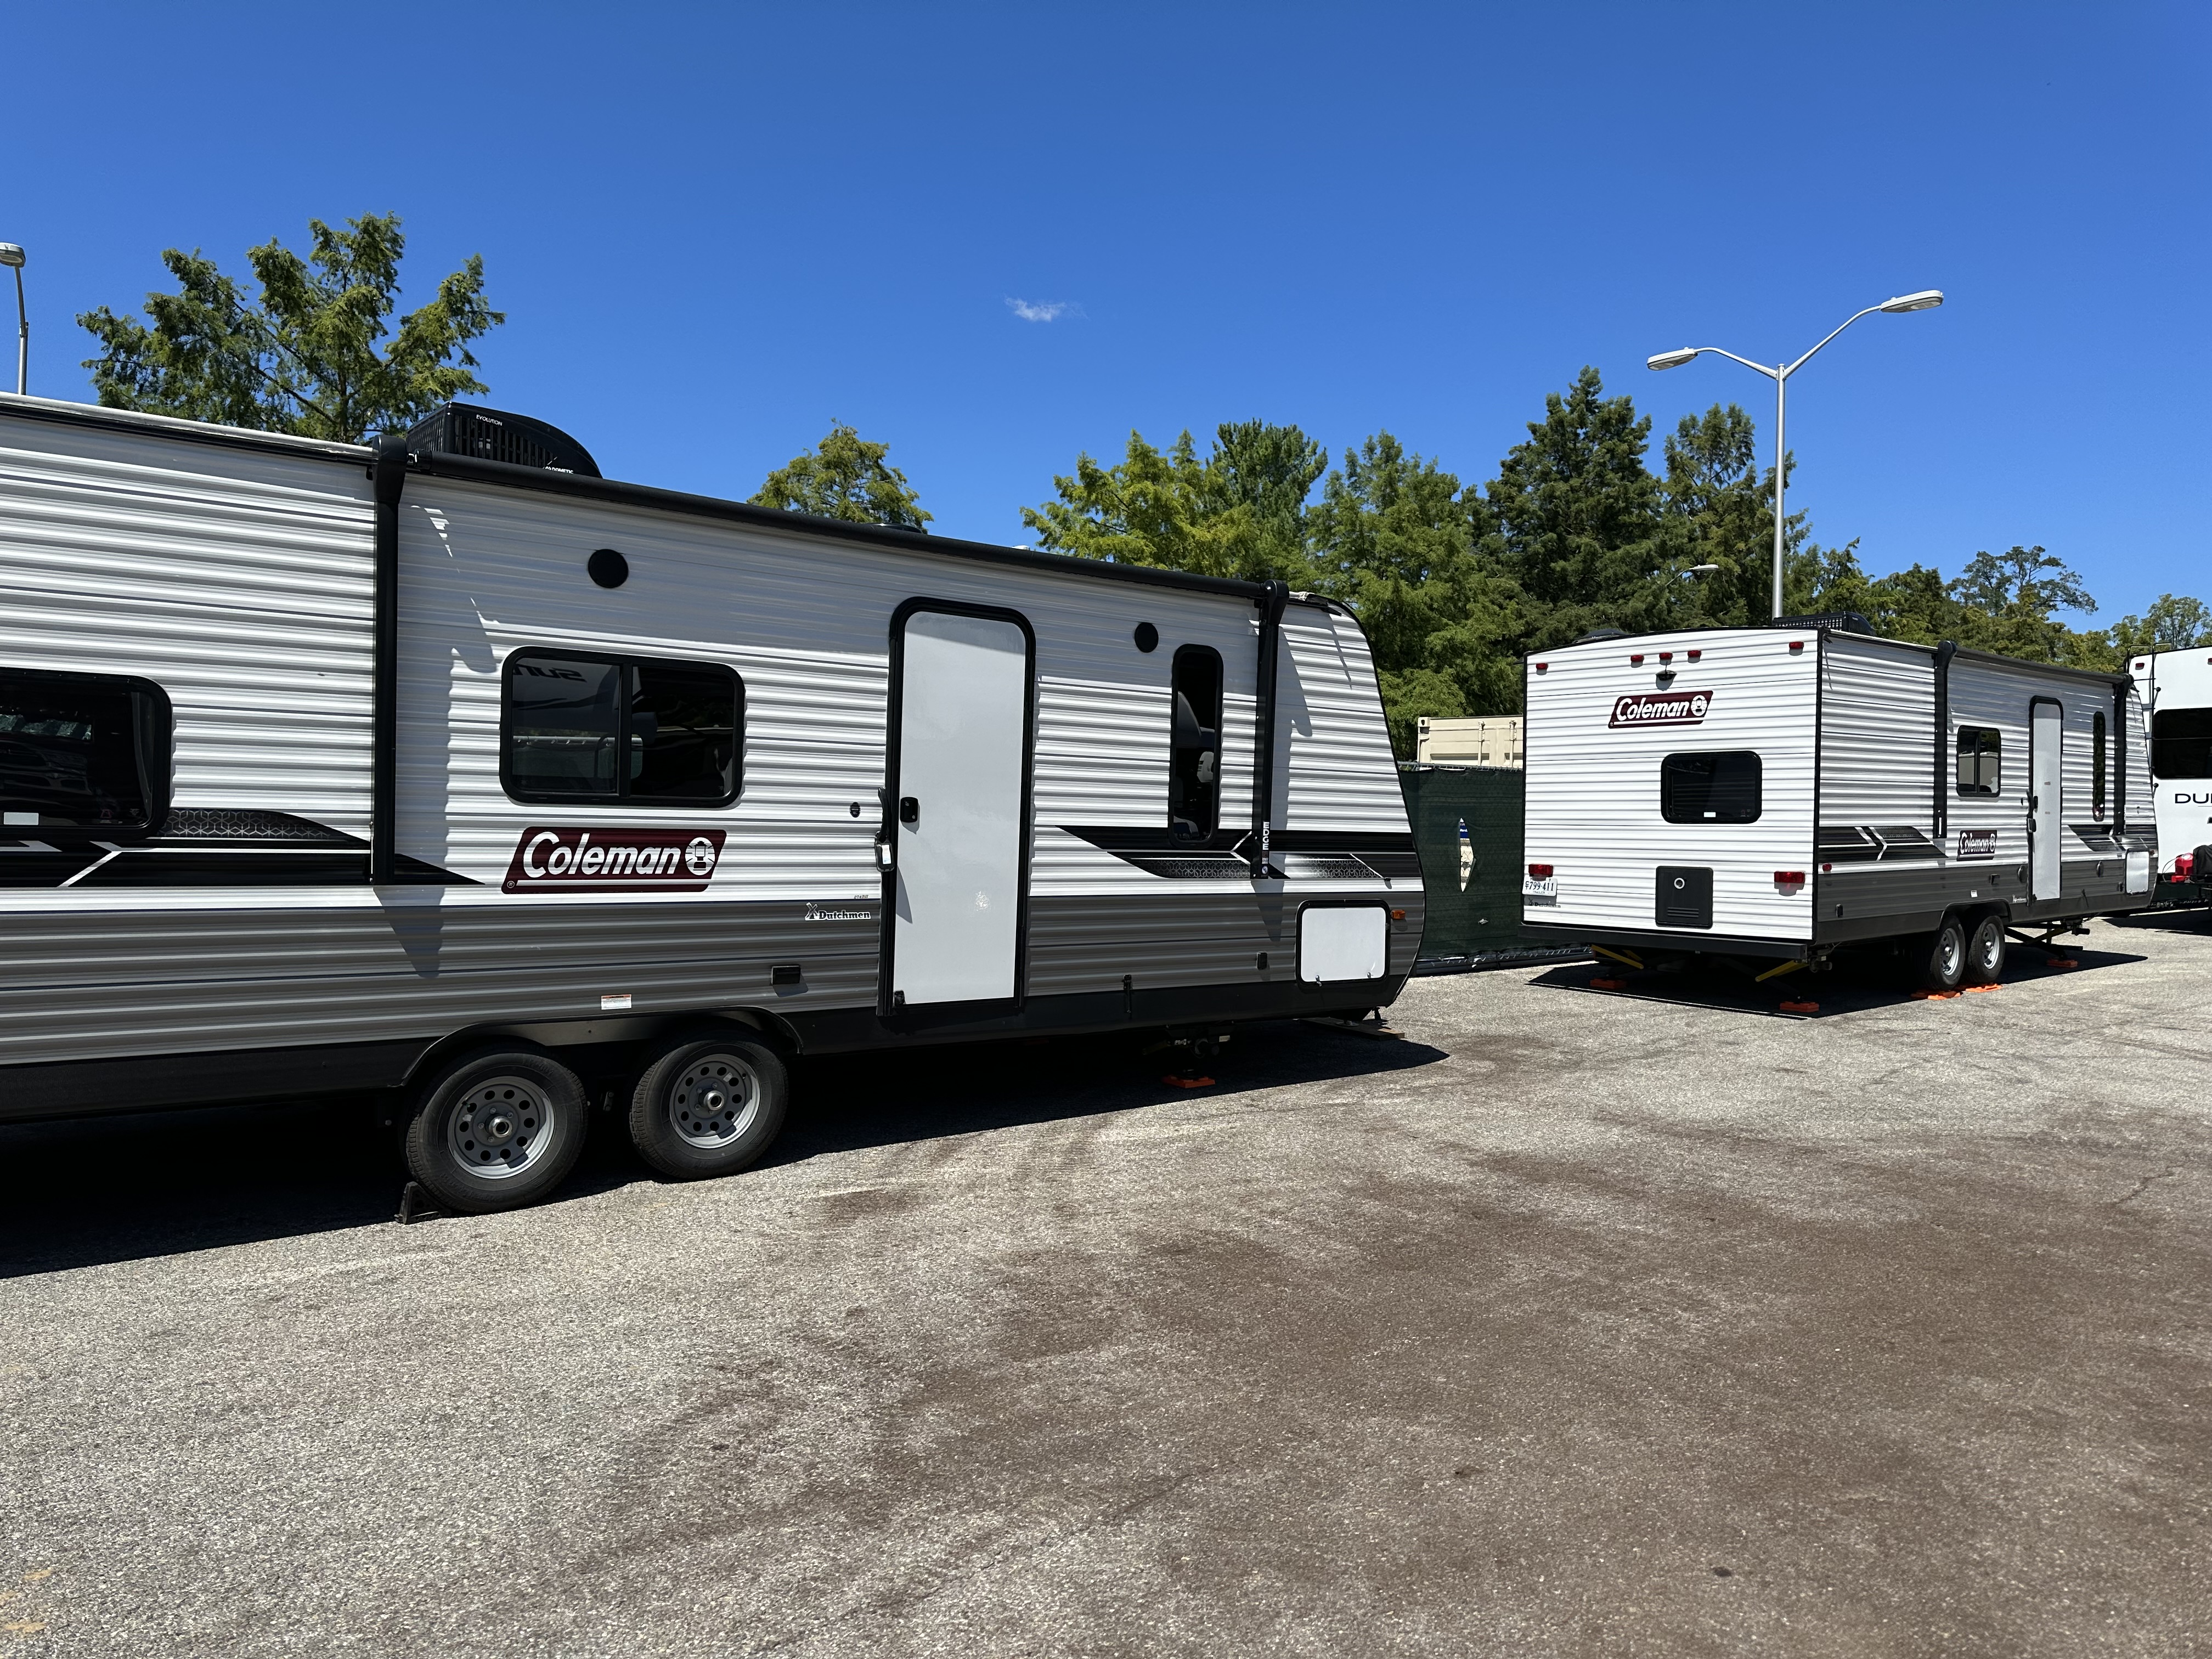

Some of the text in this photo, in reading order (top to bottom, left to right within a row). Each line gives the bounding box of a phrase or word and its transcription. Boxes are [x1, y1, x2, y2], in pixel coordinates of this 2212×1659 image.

[476, 414, 503, 426] EVOLUTION
[1616, 697, 1690, 721] Coleman
[2175, 793, 2212, 804] DU
[1960, 832, 1989, 854] Coleman
[523, 831, 681, 878] Coleman
[818, 910, 870, 920] Dutchmen
